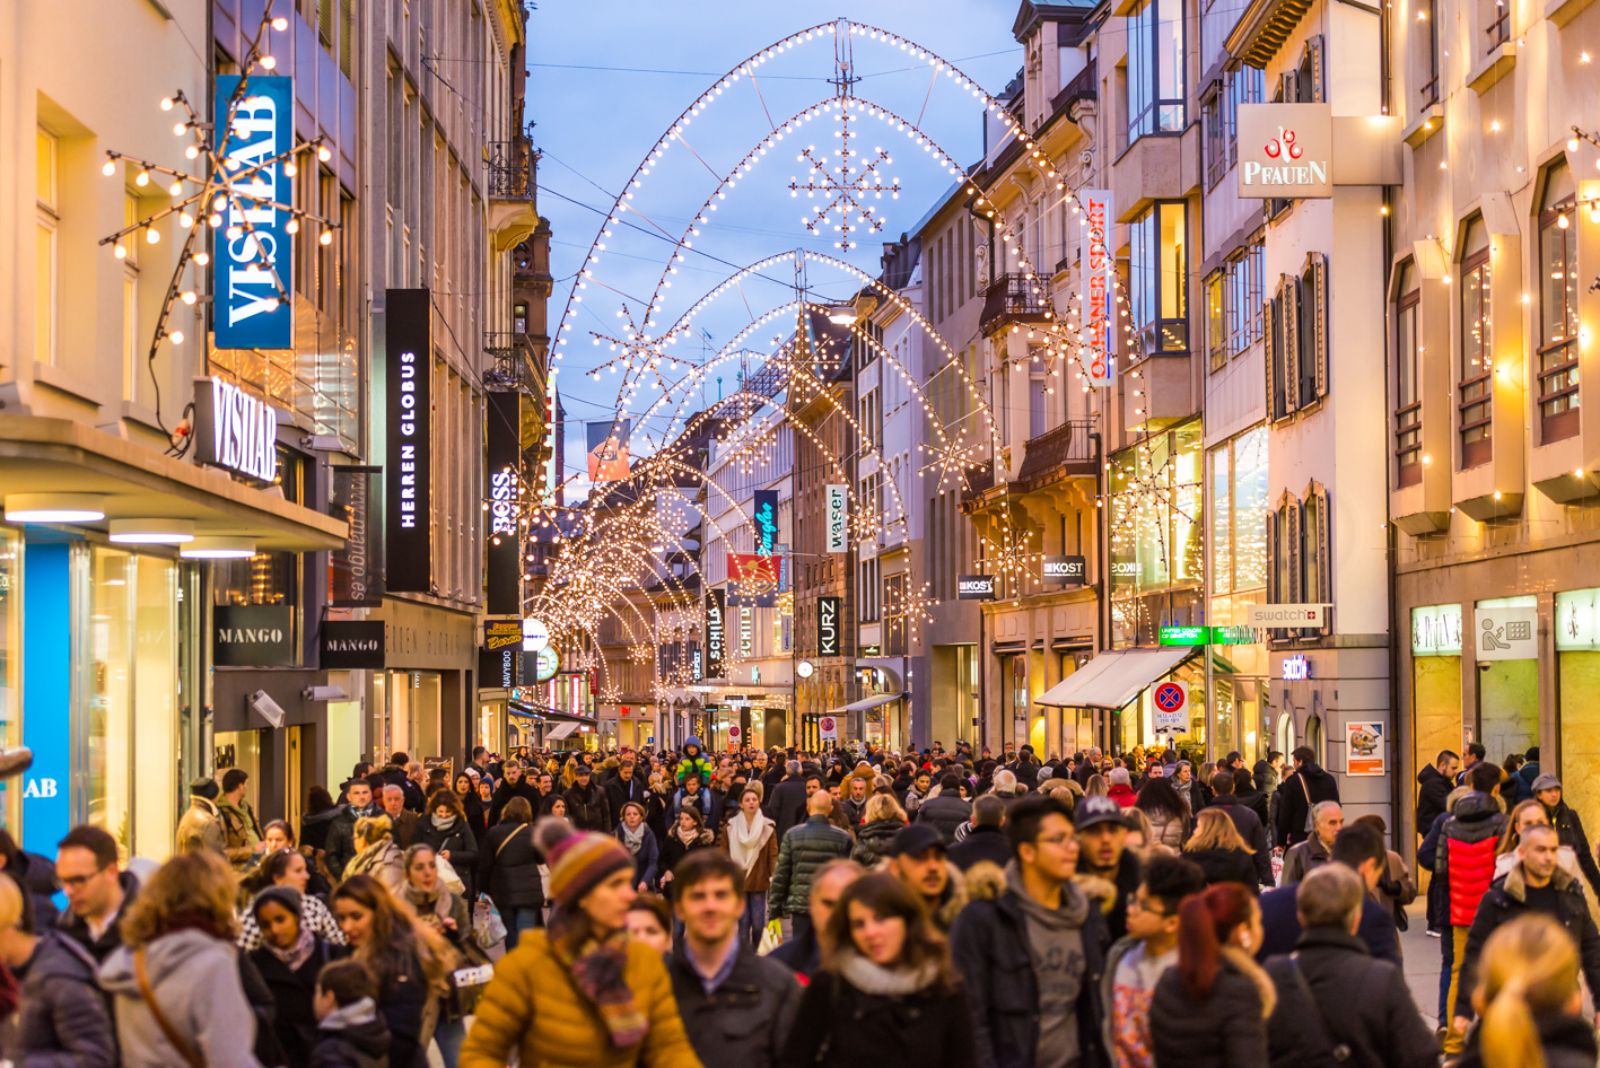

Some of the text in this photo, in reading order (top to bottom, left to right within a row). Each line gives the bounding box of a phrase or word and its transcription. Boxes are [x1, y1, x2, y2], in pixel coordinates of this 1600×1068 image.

[1244, 161, 1327, 185] PFAUEN
[229, 95, 278, 328] VISILAB
[212, 376, 277, 482] VISILAB
[401, 352, 416, 528] HERREN GLOBUS
[492, 474, 511, 533] BOSS
[832, 489, 842, 549] waser
[219, 628, 283, 644] MANGO
[708, 608, 721, 660] SCHILD
[821, 600, 835, 654] KURZ
[1254, 608, 1306, 621] swatch
[326, 639, 379, 652] MANGO
